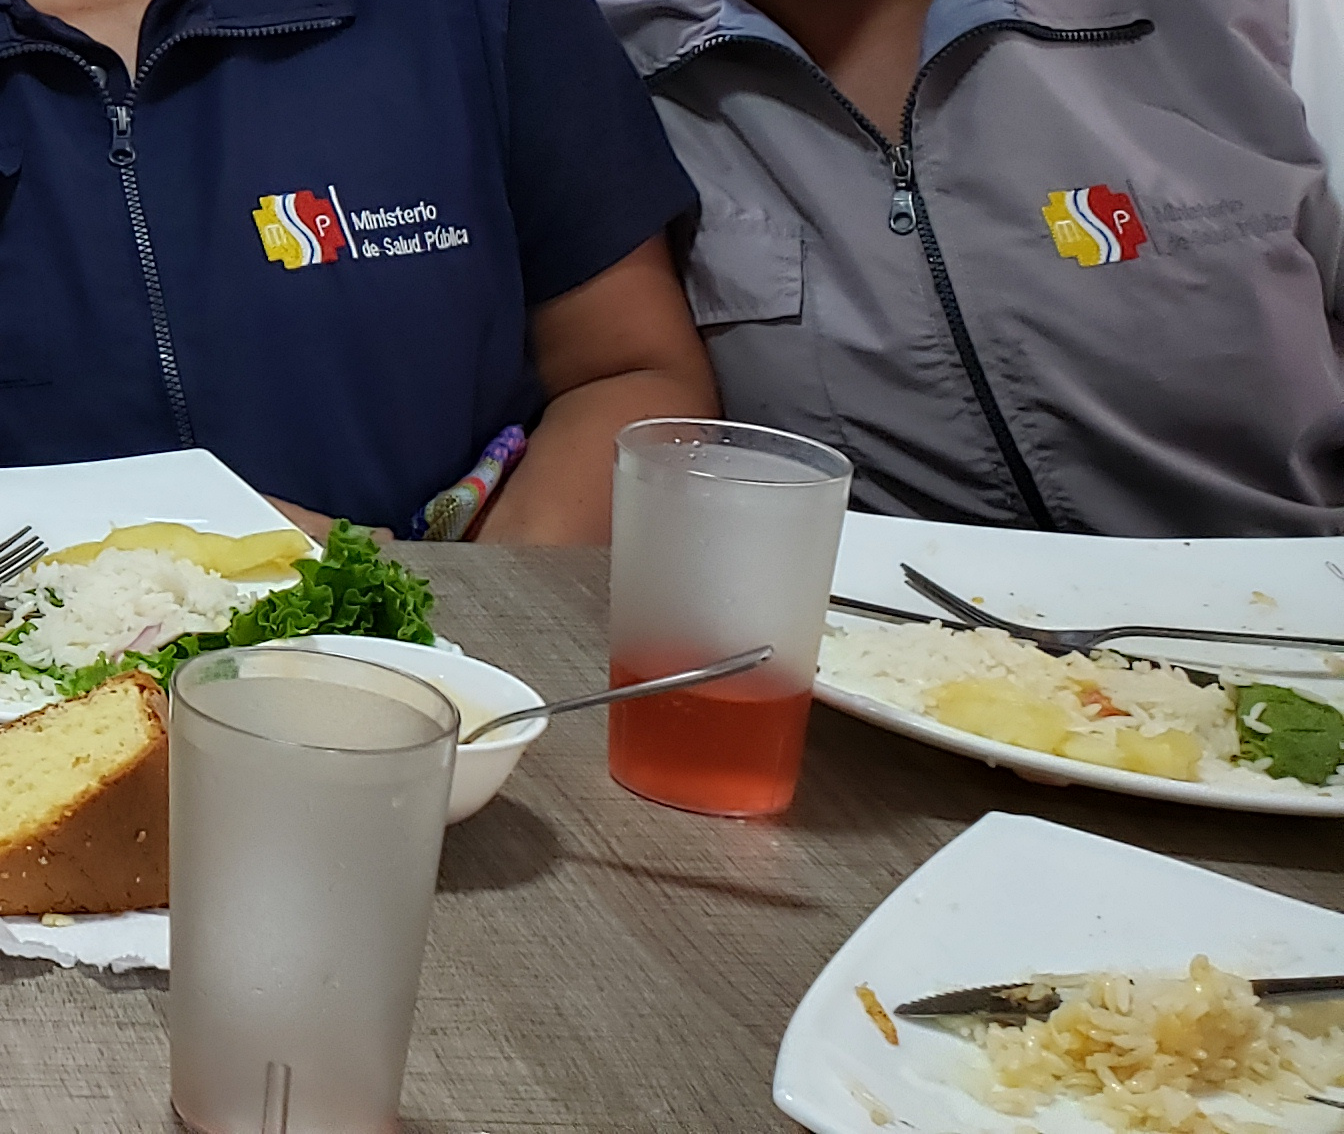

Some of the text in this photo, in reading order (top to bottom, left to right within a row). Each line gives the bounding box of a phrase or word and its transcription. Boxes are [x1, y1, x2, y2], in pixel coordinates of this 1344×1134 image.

[350, 201, 437, 231] Ministerio
[362, 225, 469, 258] de Salud Pública
